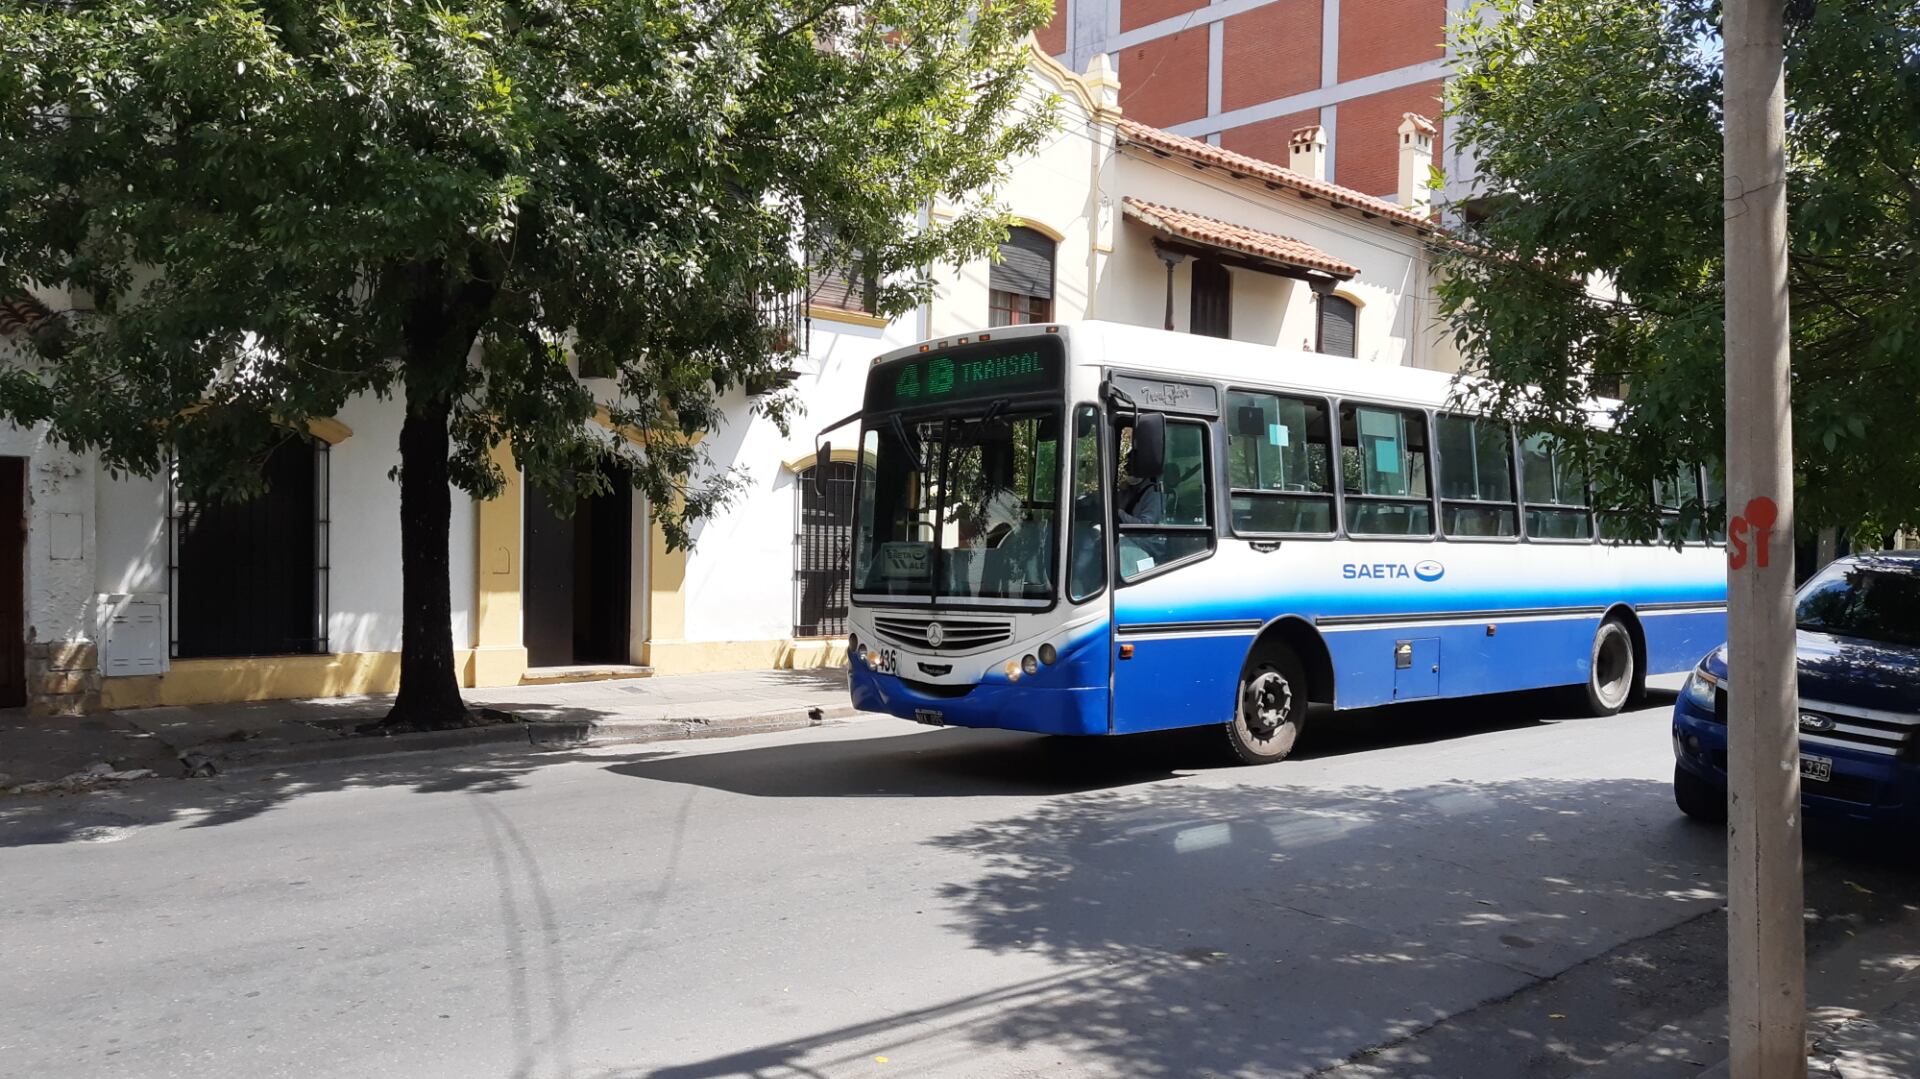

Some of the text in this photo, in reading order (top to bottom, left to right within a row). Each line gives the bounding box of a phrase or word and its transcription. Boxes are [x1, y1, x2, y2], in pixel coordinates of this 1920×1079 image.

[961, 351, 1044, 383] TRANSAL
[1342, 563, 1410, 579] SAETA
[1804, 760, 1828, 777] 335
